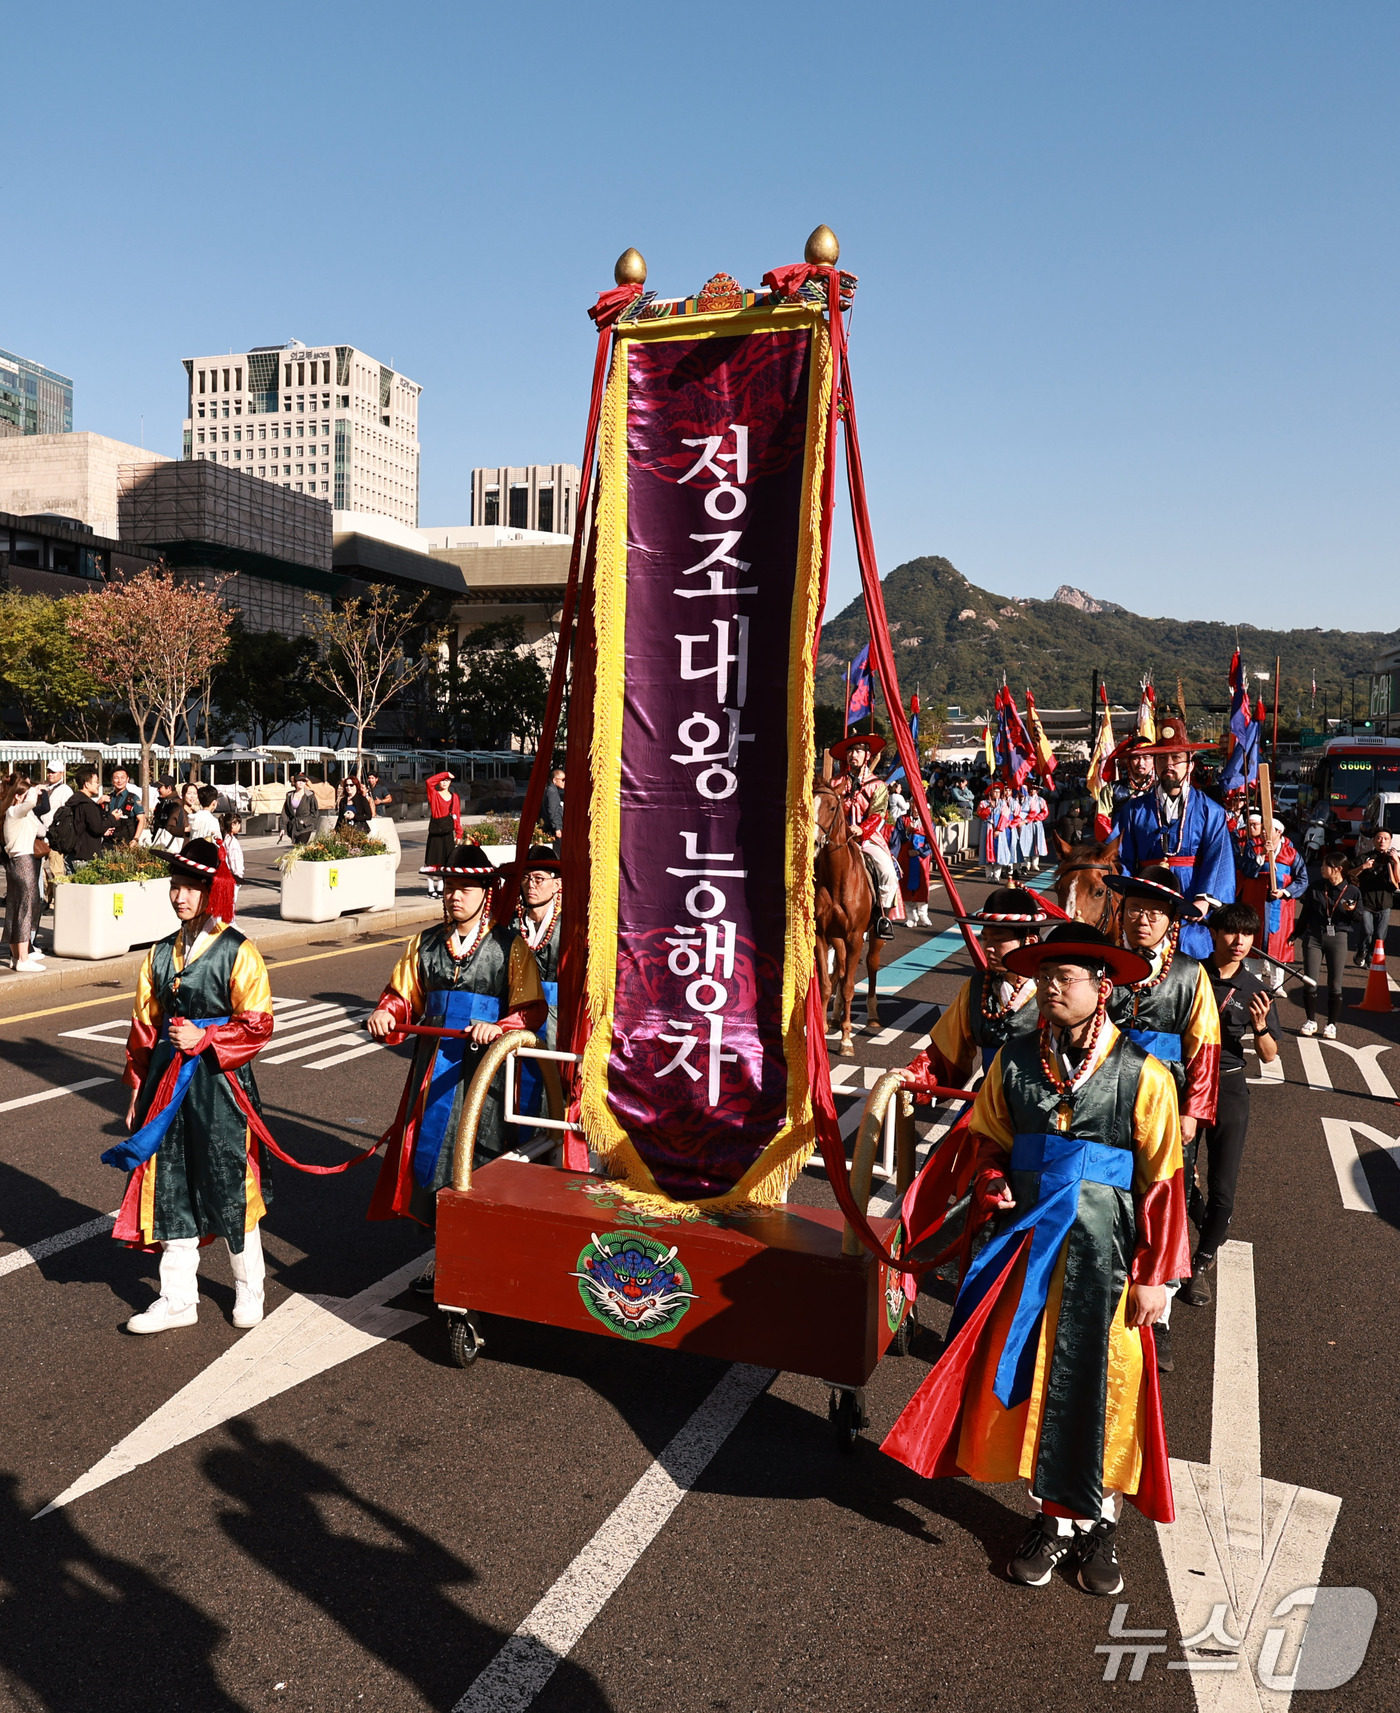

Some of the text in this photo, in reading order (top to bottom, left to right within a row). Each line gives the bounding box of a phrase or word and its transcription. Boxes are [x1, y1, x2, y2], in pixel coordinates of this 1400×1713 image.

[652, 423, 758, 1107] 정조대왕 능행차
[1340, 761, 1372, 770] G6005
